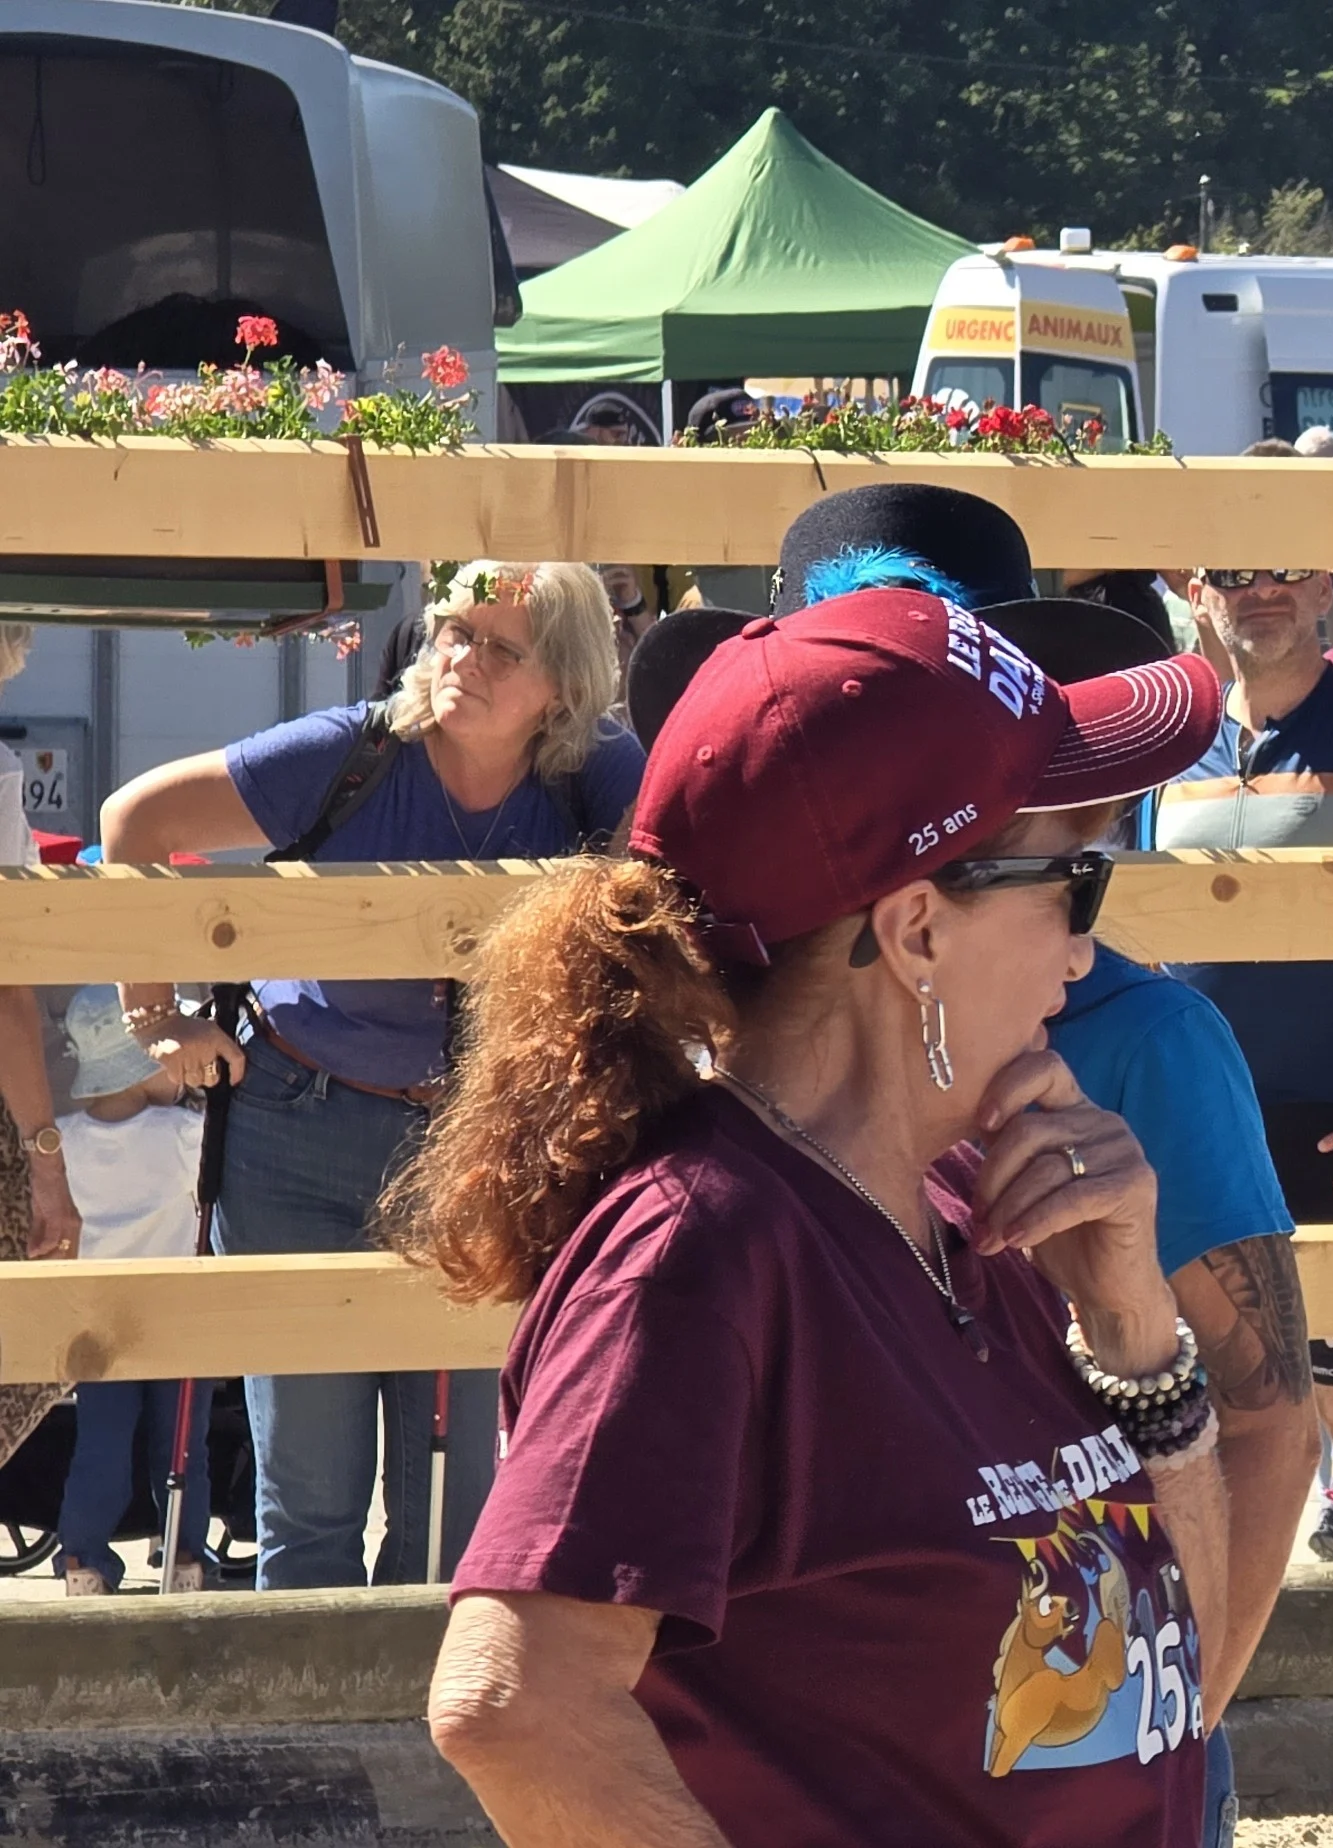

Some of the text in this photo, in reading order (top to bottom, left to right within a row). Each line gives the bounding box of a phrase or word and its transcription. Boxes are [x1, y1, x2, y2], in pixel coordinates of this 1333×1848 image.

[1028, 313, 1123, 348] ANIMAUX
[908, 803, 978, 856] 25 ans
[966, 1494, 997, 1526] LE
[1127, 1620, 1188, 1765] 25
